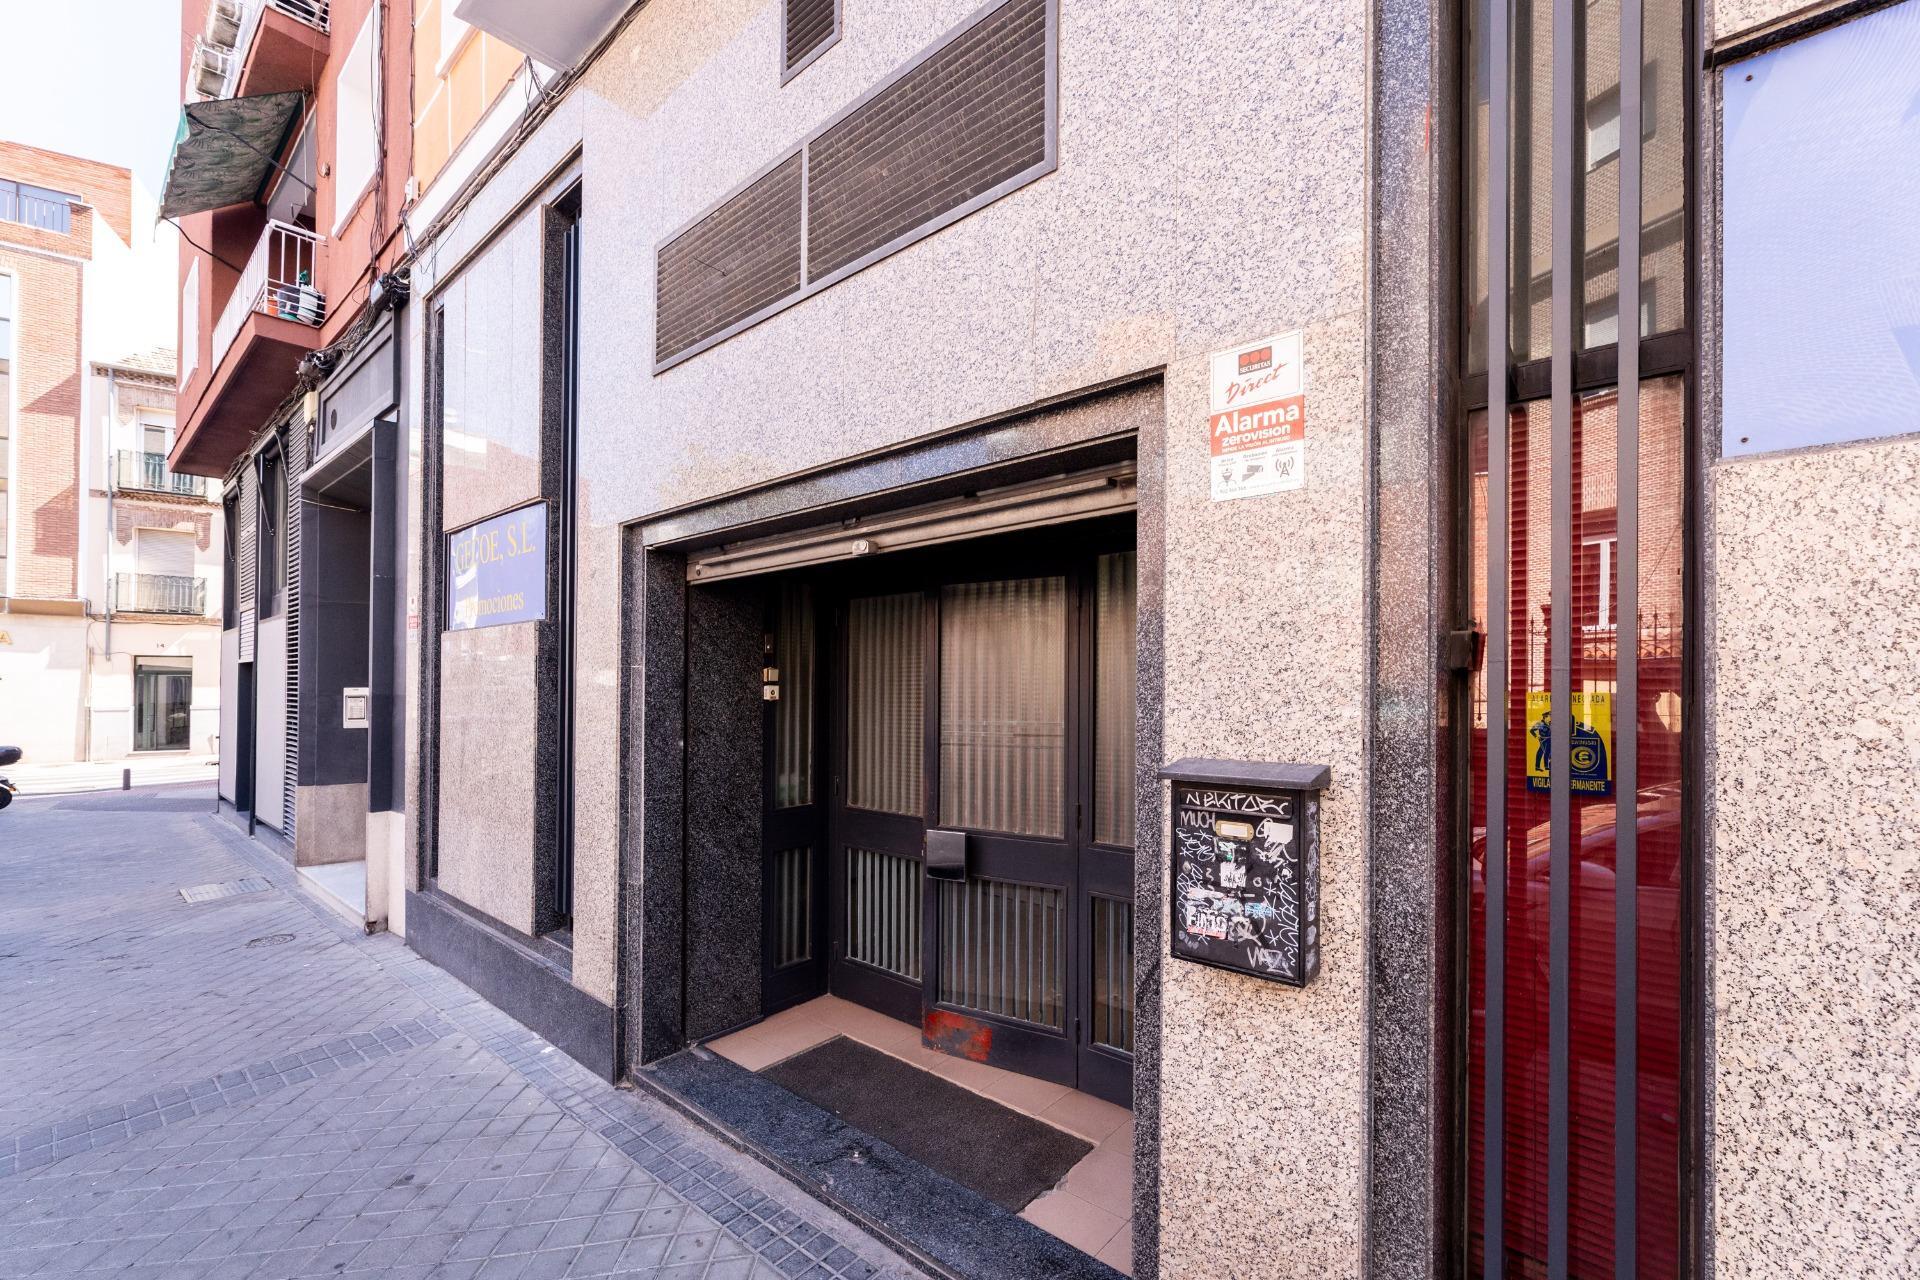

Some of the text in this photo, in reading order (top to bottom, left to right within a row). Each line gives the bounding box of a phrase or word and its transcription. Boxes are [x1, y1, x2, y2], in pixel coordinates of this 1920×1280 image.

[1239, 360, 1271, 374] SECURITAS
[1225, 363, 1288, 404] Direct
[1214, 404, 1300, 437] Alarma
[1222, 424, 1291, 448] zerovision
[1571, 780, 1606, 791] RMANENTE
